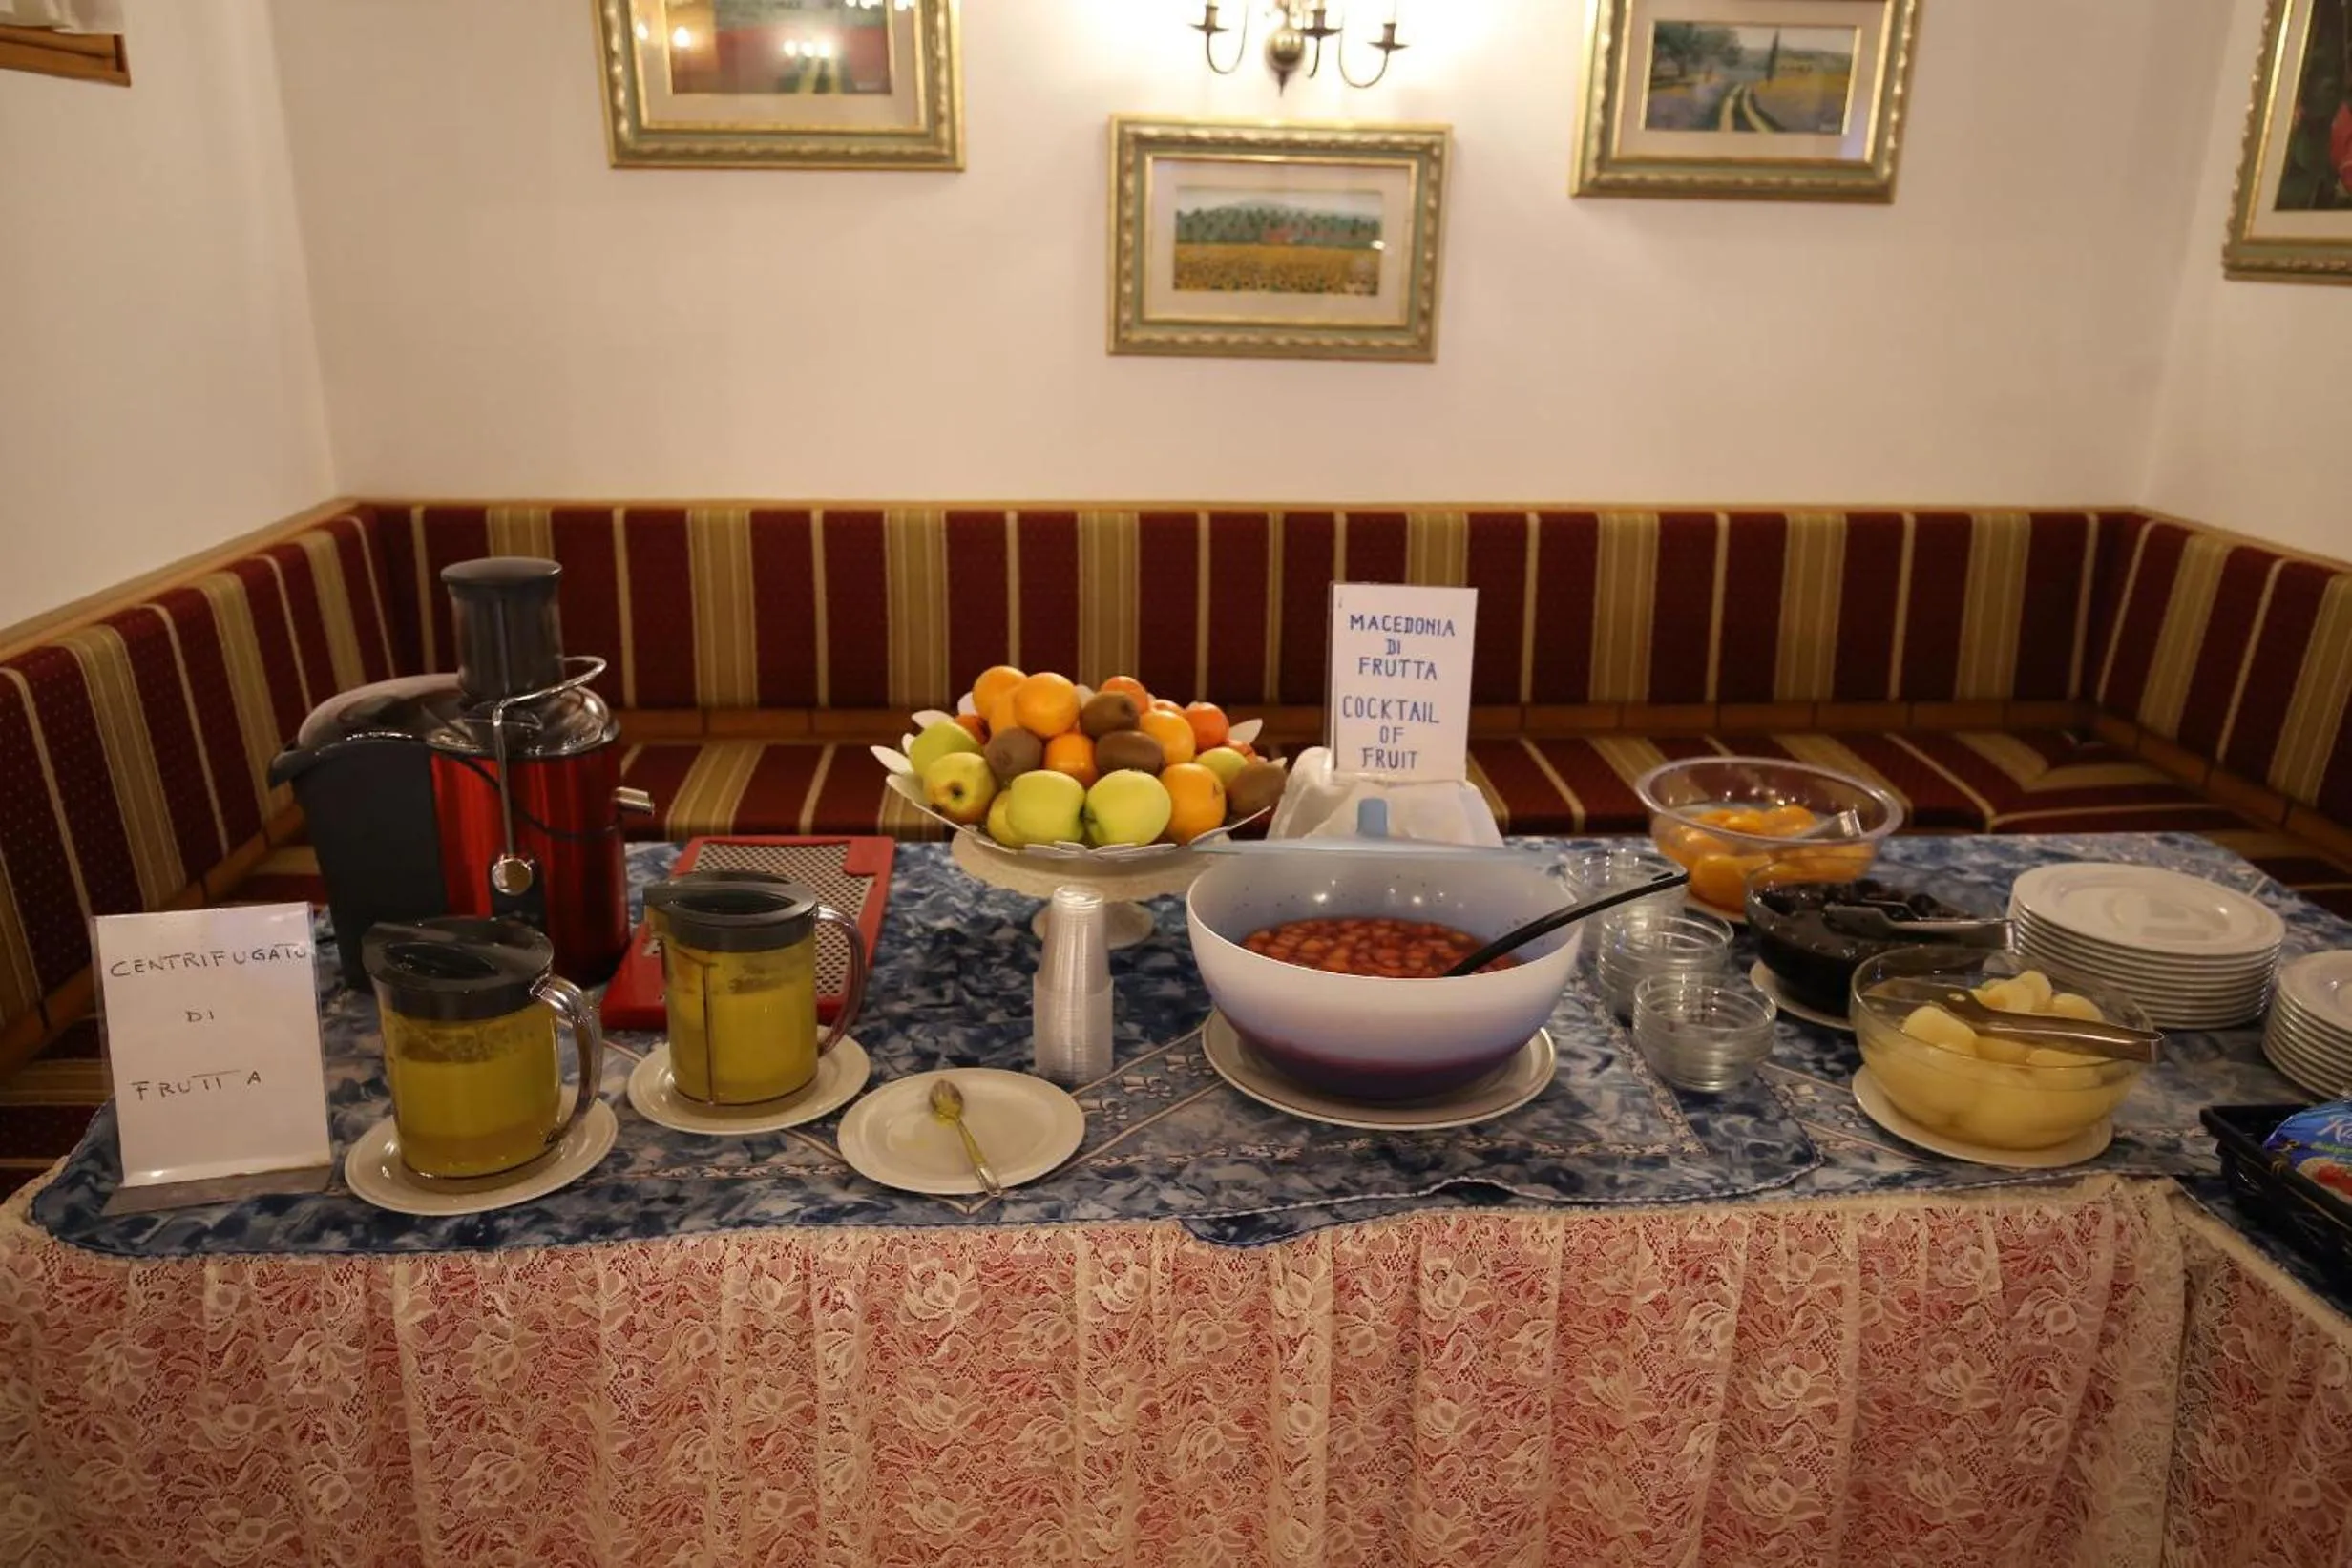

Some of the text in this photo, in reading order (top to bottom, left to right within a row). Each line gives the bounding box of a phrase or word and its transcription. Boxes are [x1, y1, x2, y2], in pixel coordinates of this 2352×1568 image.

[1349, 614, 1456, 637] MACEDONIA
[1385, 638, 1402, 656] DI
[1357, 656, 1438, 681] FRUTTA
[1342, 695, 1440, 724] COCKTAIL
[1379, 725, 1405, 744] OF
[1361, 747, 1418, 770] FRUIT
[186, 1010, 215, 1023] DI
[131, 1069, 262, 1101] FRUTTA
